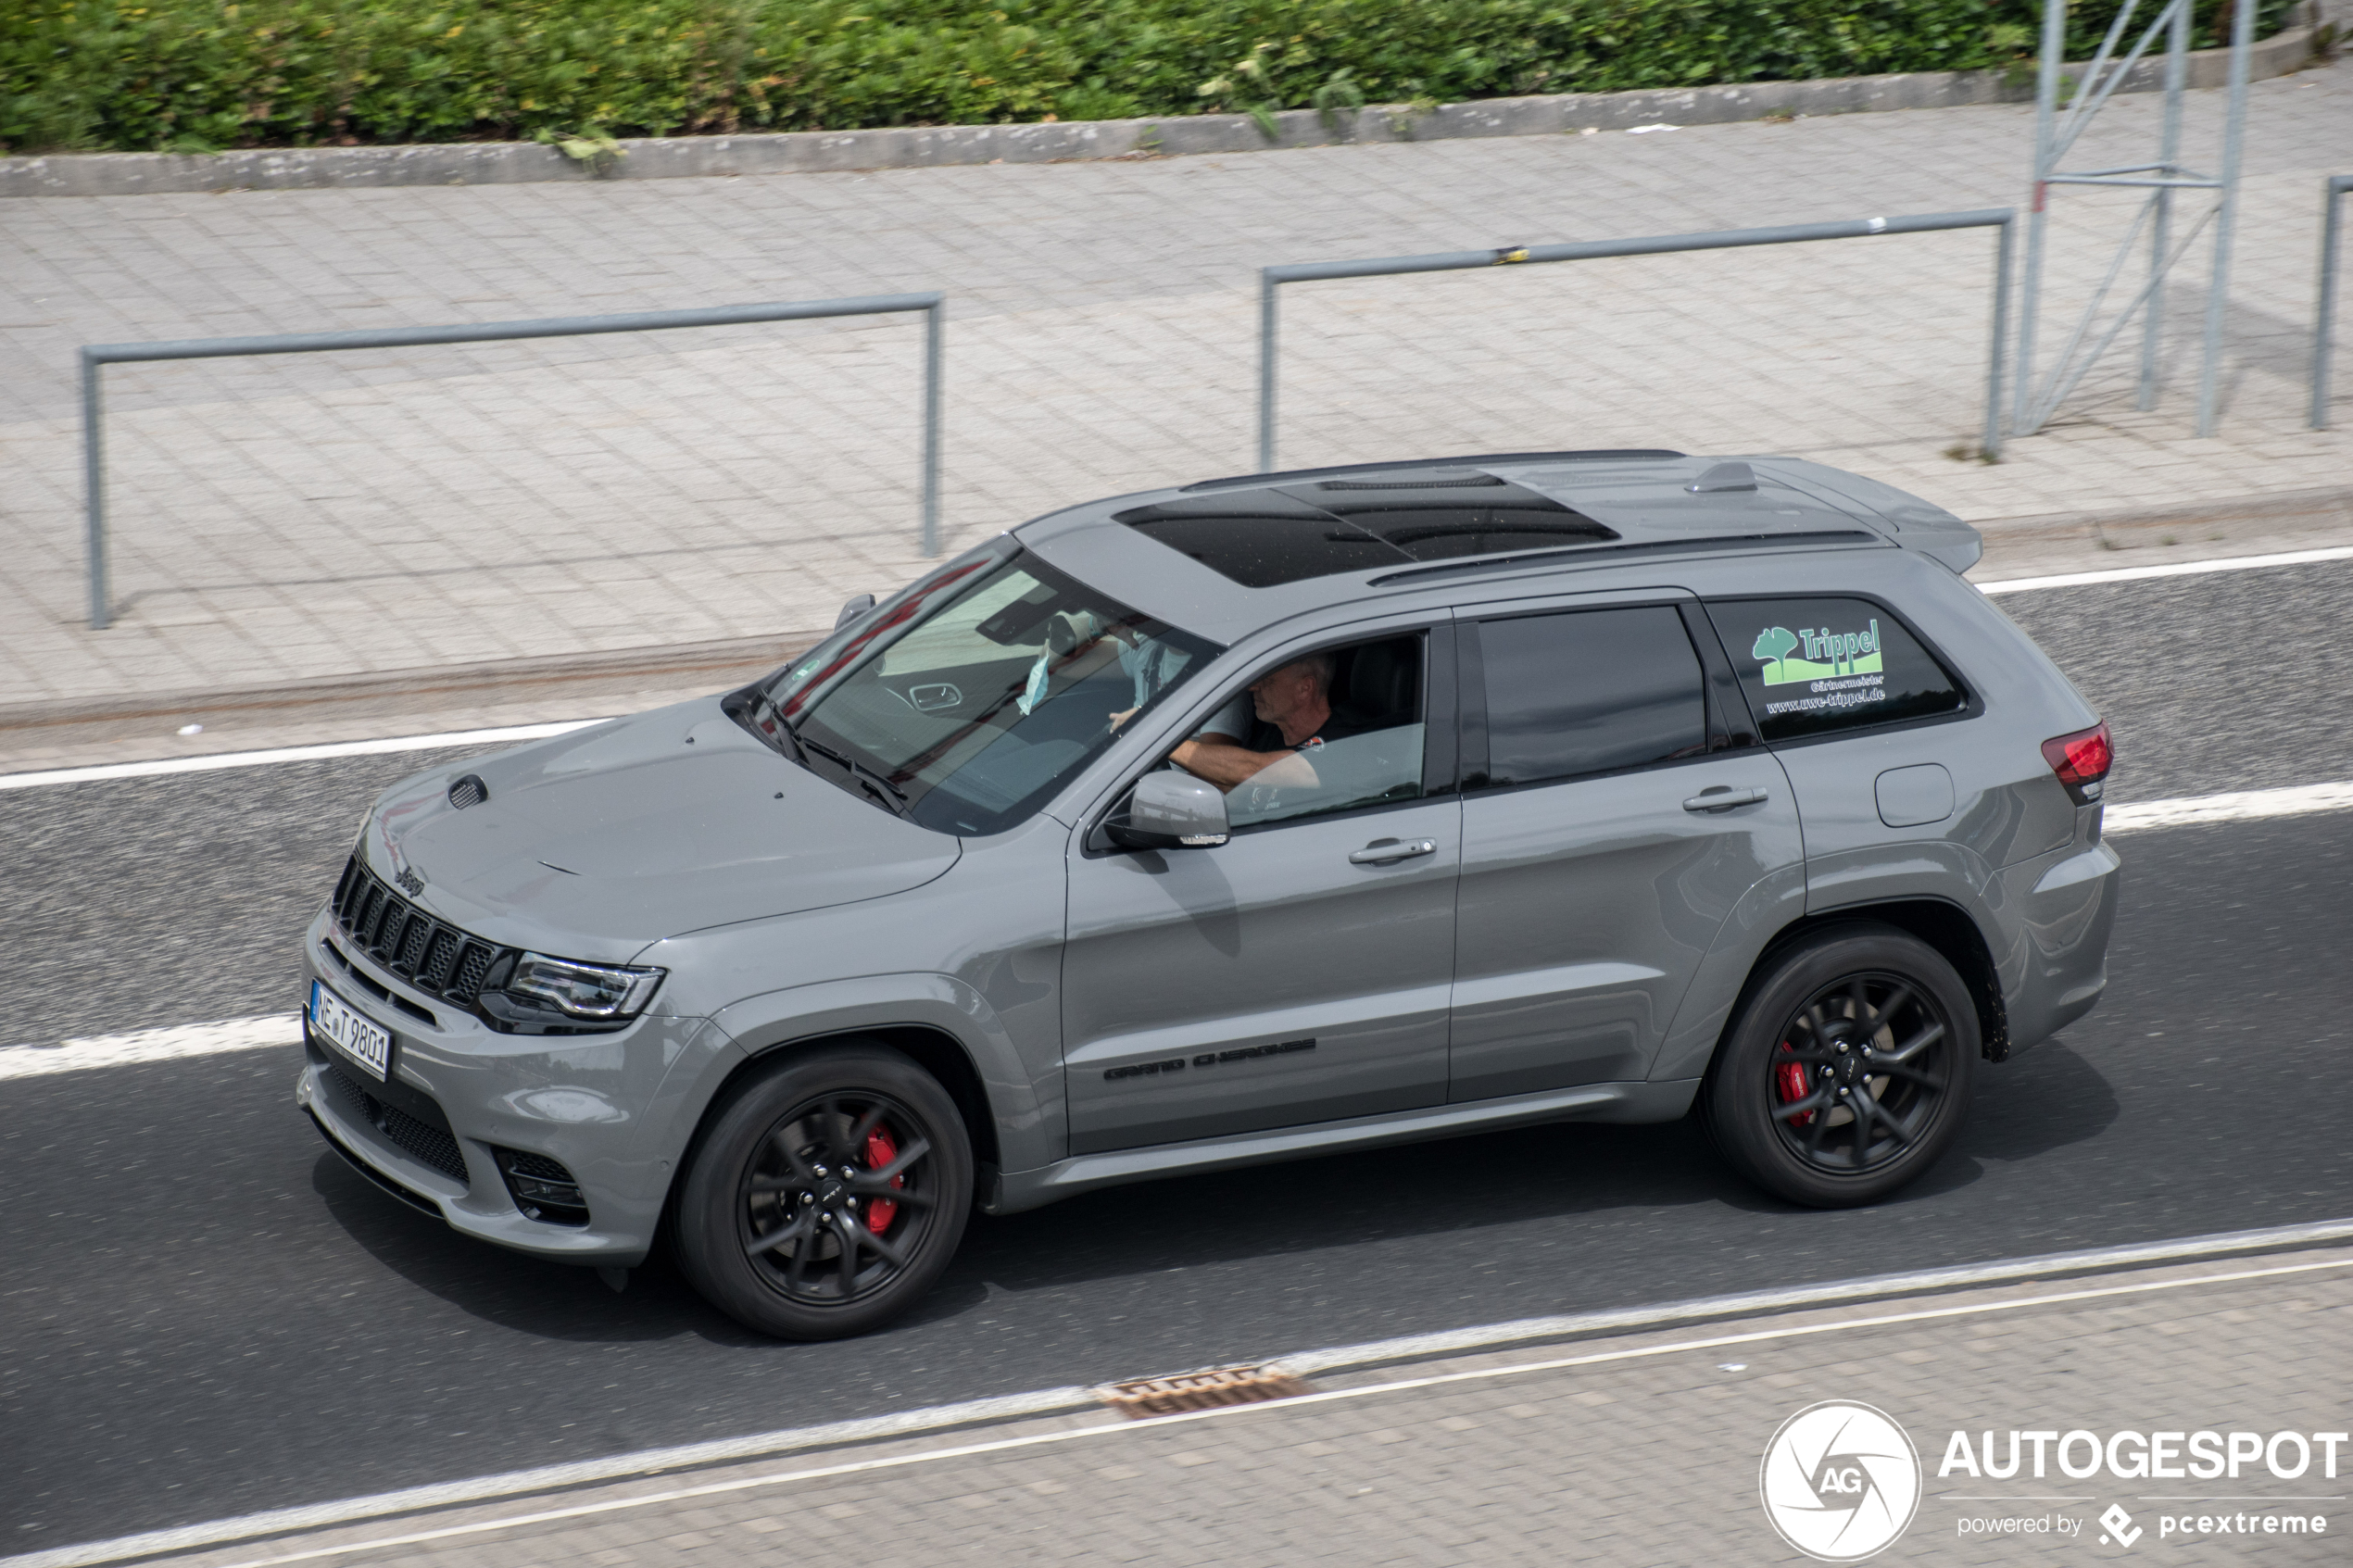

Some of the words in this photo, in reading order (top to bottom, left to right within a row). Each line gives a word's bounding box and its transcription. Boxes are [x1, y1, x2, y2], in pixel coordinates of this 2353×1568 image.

[1799, 619, 1881, 675] Trippel
[1811, 675, 1883, 692] Gärtnermeister
[1767, 688, 1885, 714] www.uwe-trippel.de
[395, 866, 424, 898] Jeep
[318, 989, 333, 1031] NE
[341, 1009, 349, 1041] T
[351, 1018, 384, 1069] 9801
